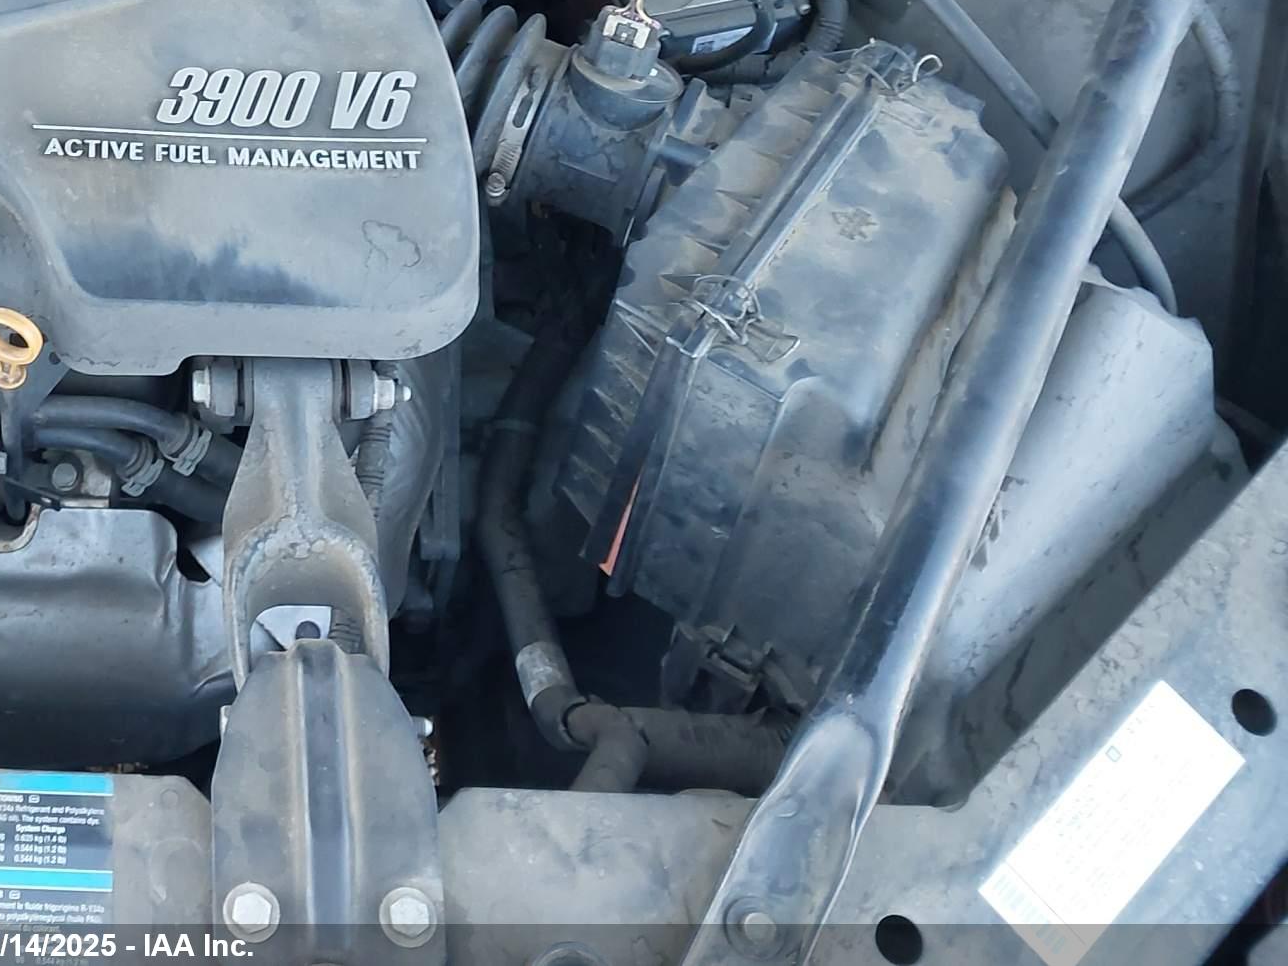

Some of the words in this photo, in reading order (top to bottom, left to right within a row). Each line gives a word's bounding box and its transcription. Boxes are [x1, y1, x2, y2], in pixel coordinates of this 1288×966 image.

[156, 66, 321, 128] 3900
[330, 70, 417, 130] V6
[44, 138, 144, 160] ACTIVE
[155, 144, 216, 164] FUEL
[228, 148, 421, 169] MANAGEMENT
[16, 824, 41, 833] System
[41, 825, 66, 834] Charge
